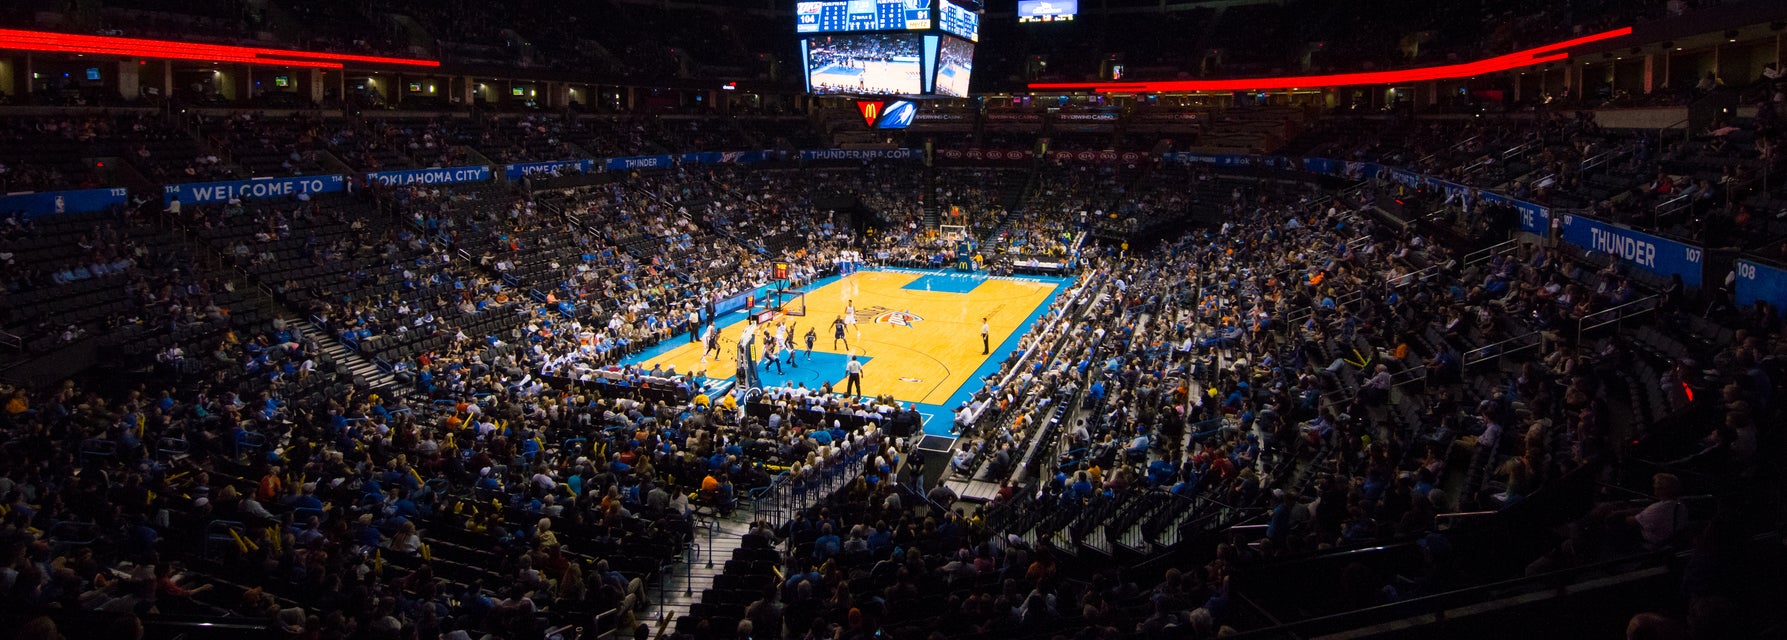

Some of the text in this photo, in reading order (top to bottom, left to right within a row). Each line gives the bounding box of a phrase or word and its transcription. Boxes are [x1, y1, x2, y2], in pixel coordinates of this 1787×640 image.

[801, 15, 815, 23] 104
[917, 10, 928, 19] 91
[625, 158, 657, 169] THUNDER
[522, 165, 549, 176] HOME
[379, 169, 480, 186] OKLAHOMA CITY
[110, 188, 126, 197] 113
[164, 185, 180, 193] 114
[192, 180, 323, 201] WELCOME TO
[1519, 207, 1535, 228] THE
[1591, 227, 1656, 268] THUNDER
[1686, 247, 1700, 263] 107
[1738, 262, 1756, 280] 108
